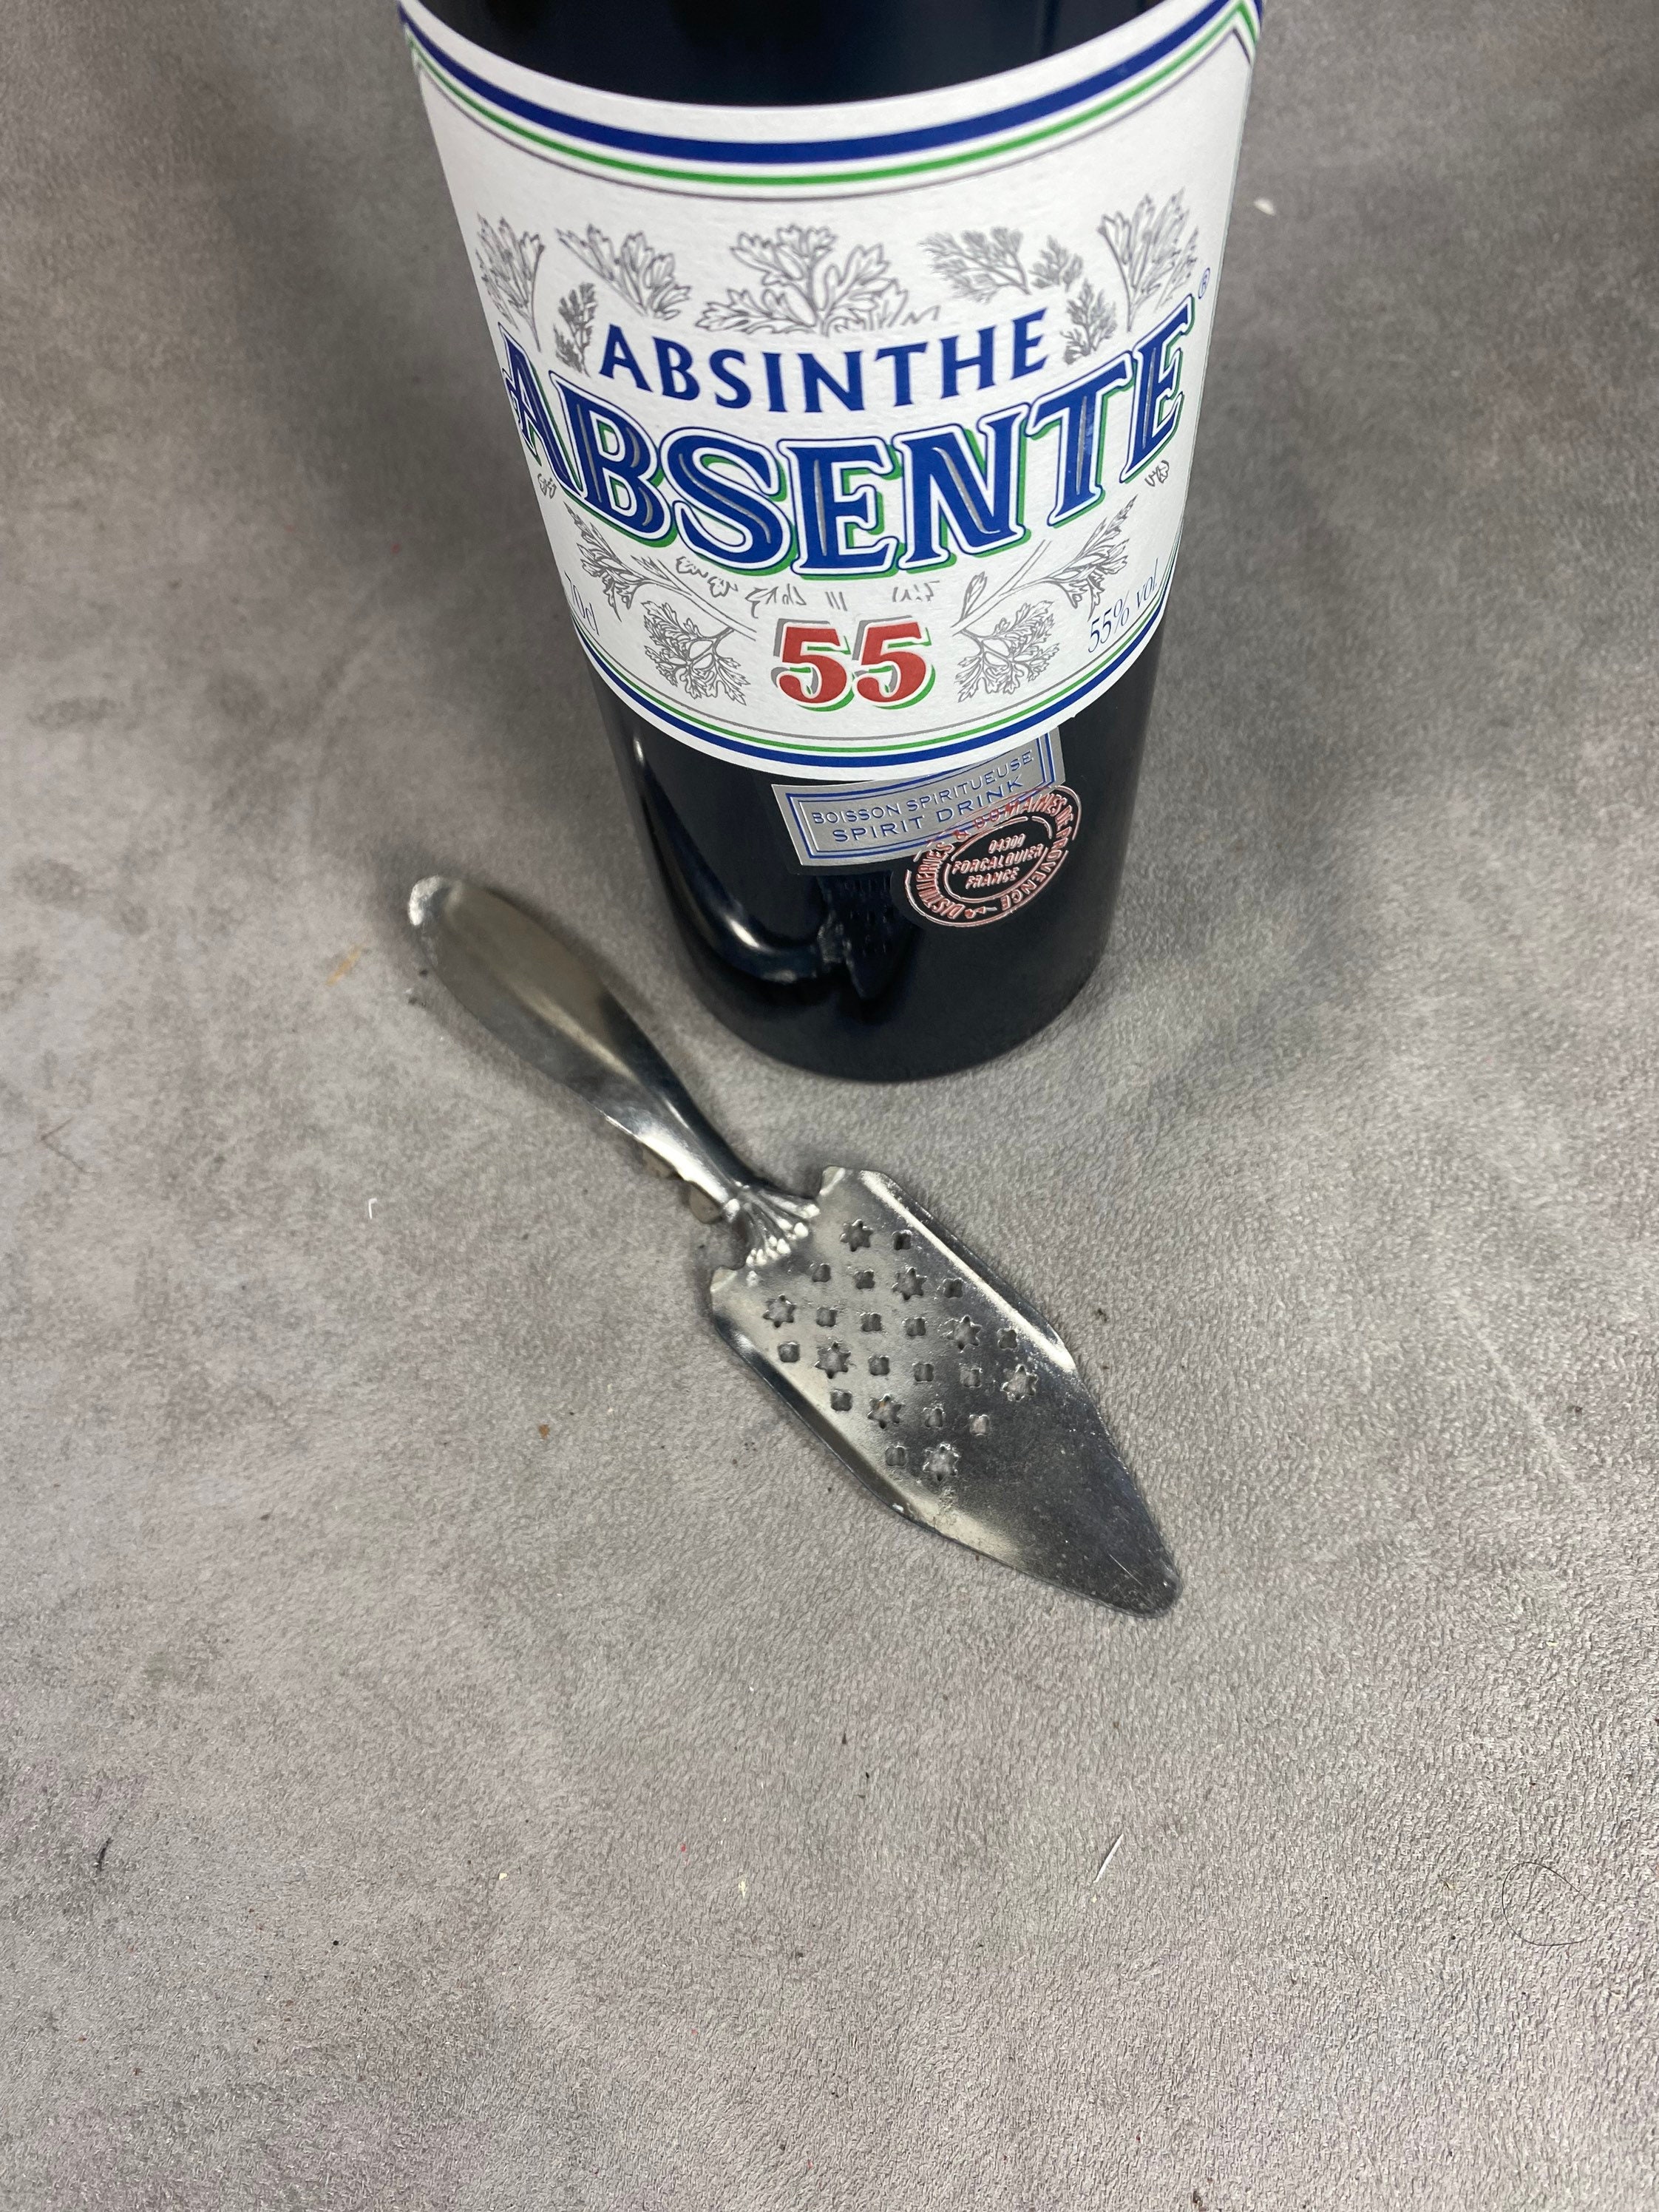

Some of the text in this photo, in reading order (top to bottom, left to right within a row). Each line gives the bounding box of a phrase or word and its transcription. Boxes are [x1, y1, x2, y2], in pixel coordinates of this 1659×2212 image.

[600, 308, 1048, 413] ABSINTHE
[1088, 589, 1130, 654] 55%
[770, 614, 936, 713] 55
[812, 748, 1034, 825] BOISSON SPIRITUEUSE
[832, 774, 1025, 843] SPIRIT DRINK
[972, 793, 1068, 830] DOMAINES
[951, 843, 1045, 875] FORCALQUIER
[988, 832, 1027, 854] 04300
[1000, 825, 1073, 912] PROVENCE
[915, 841, 966, 920] DISTILLERIES
[965, 866, 1020, 890] FRANCE
